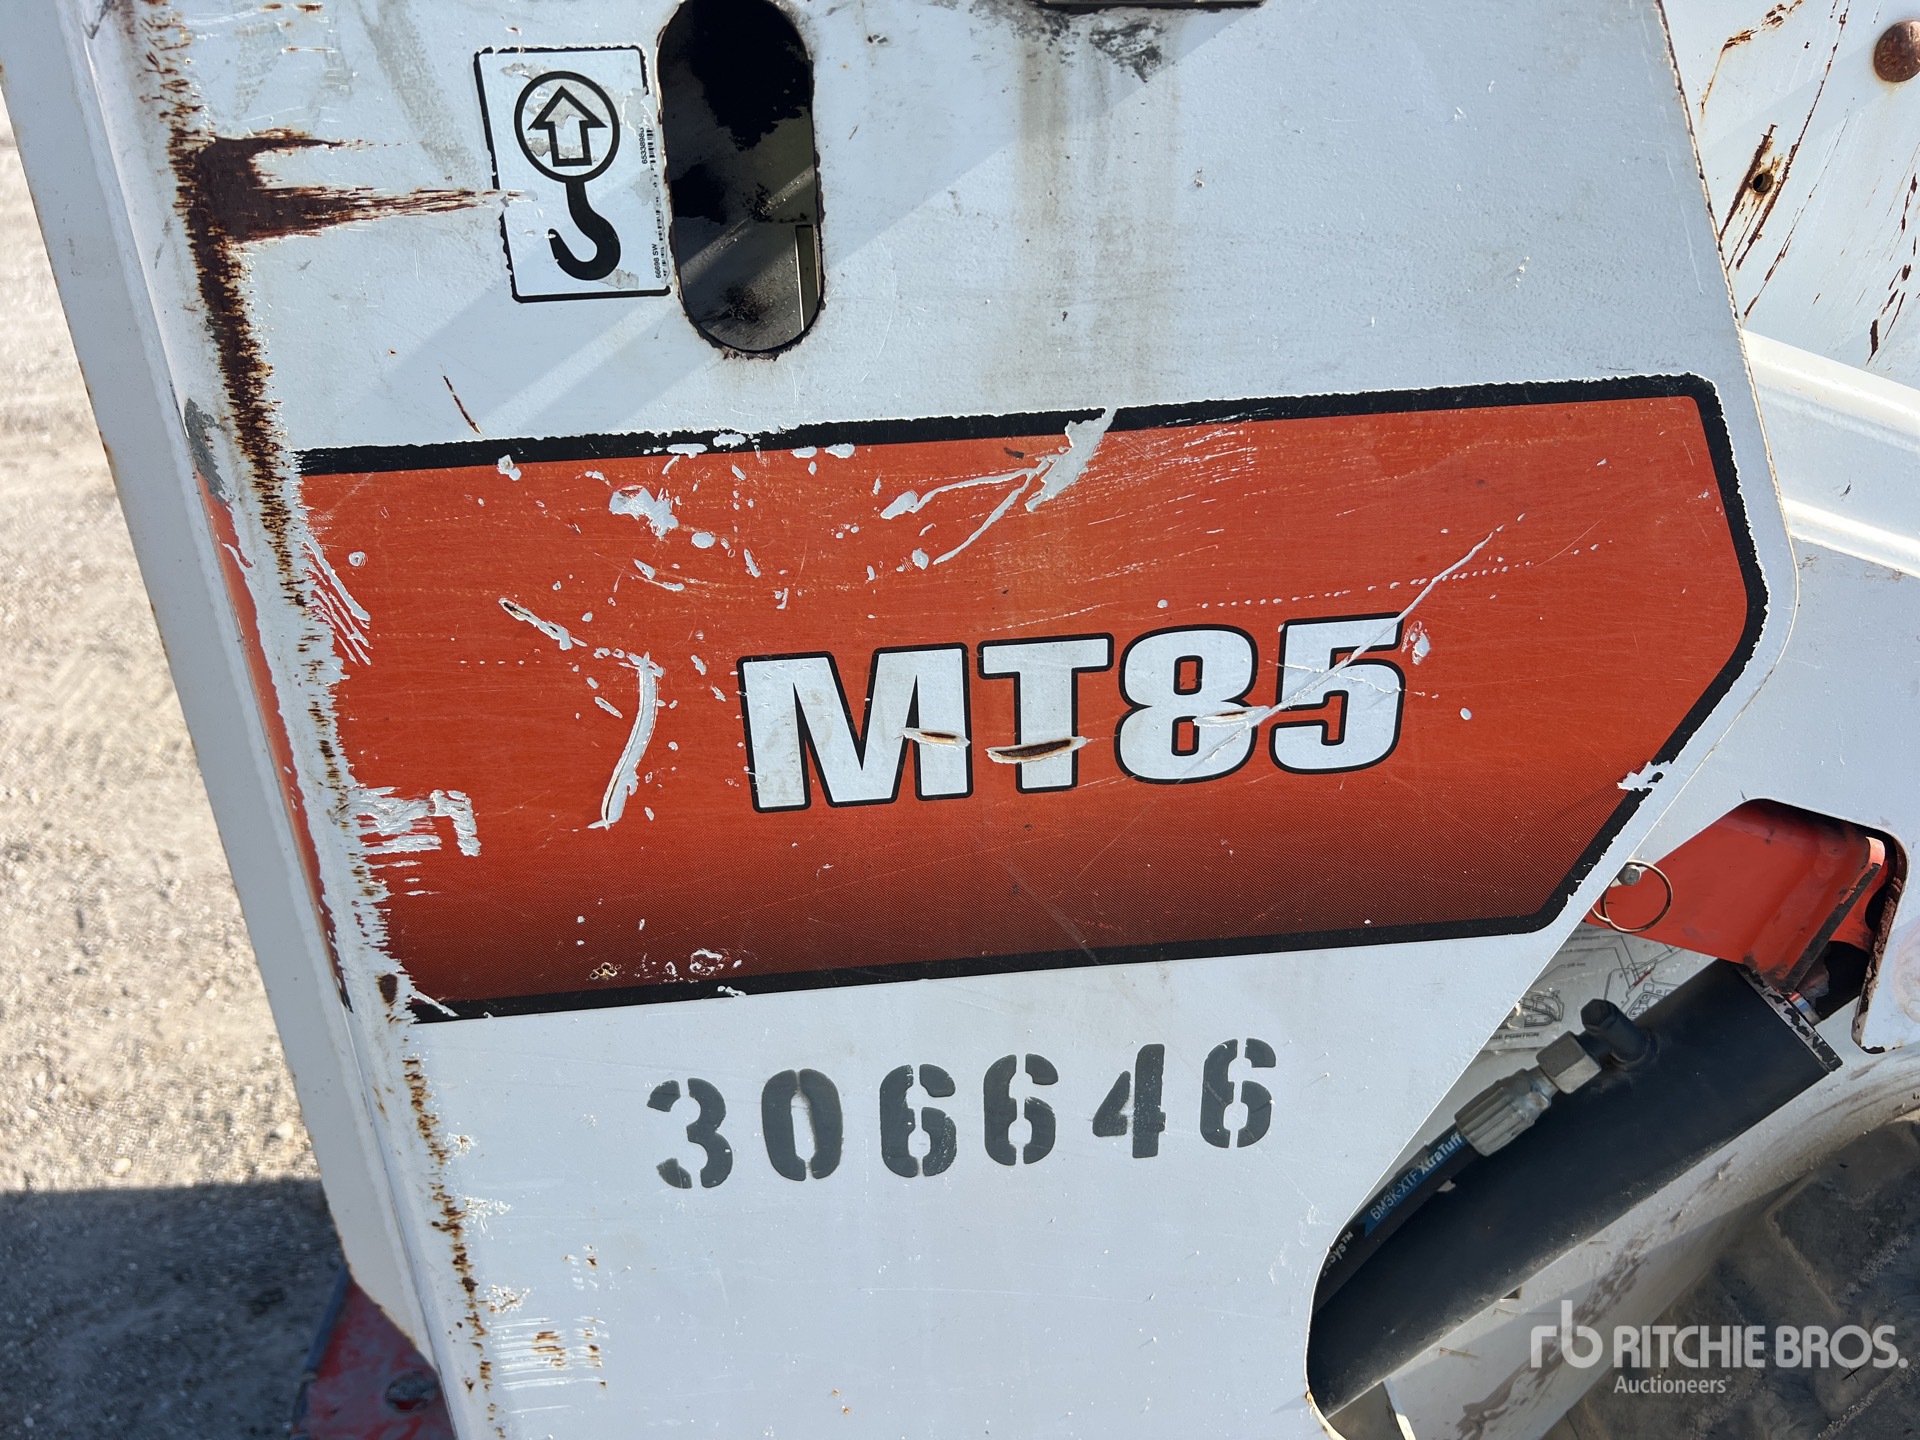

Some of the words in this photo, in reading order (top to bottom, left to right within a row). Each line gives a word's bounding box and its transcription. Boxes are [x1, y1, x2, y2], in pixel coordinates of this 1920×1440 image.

[651, 243, 659, 256] SW
[736, 611, 1405, 813] MT85
[646, 1037, 1277, 1190] 306646
[1417, 1131, 1463, 1175] XtraTuff
